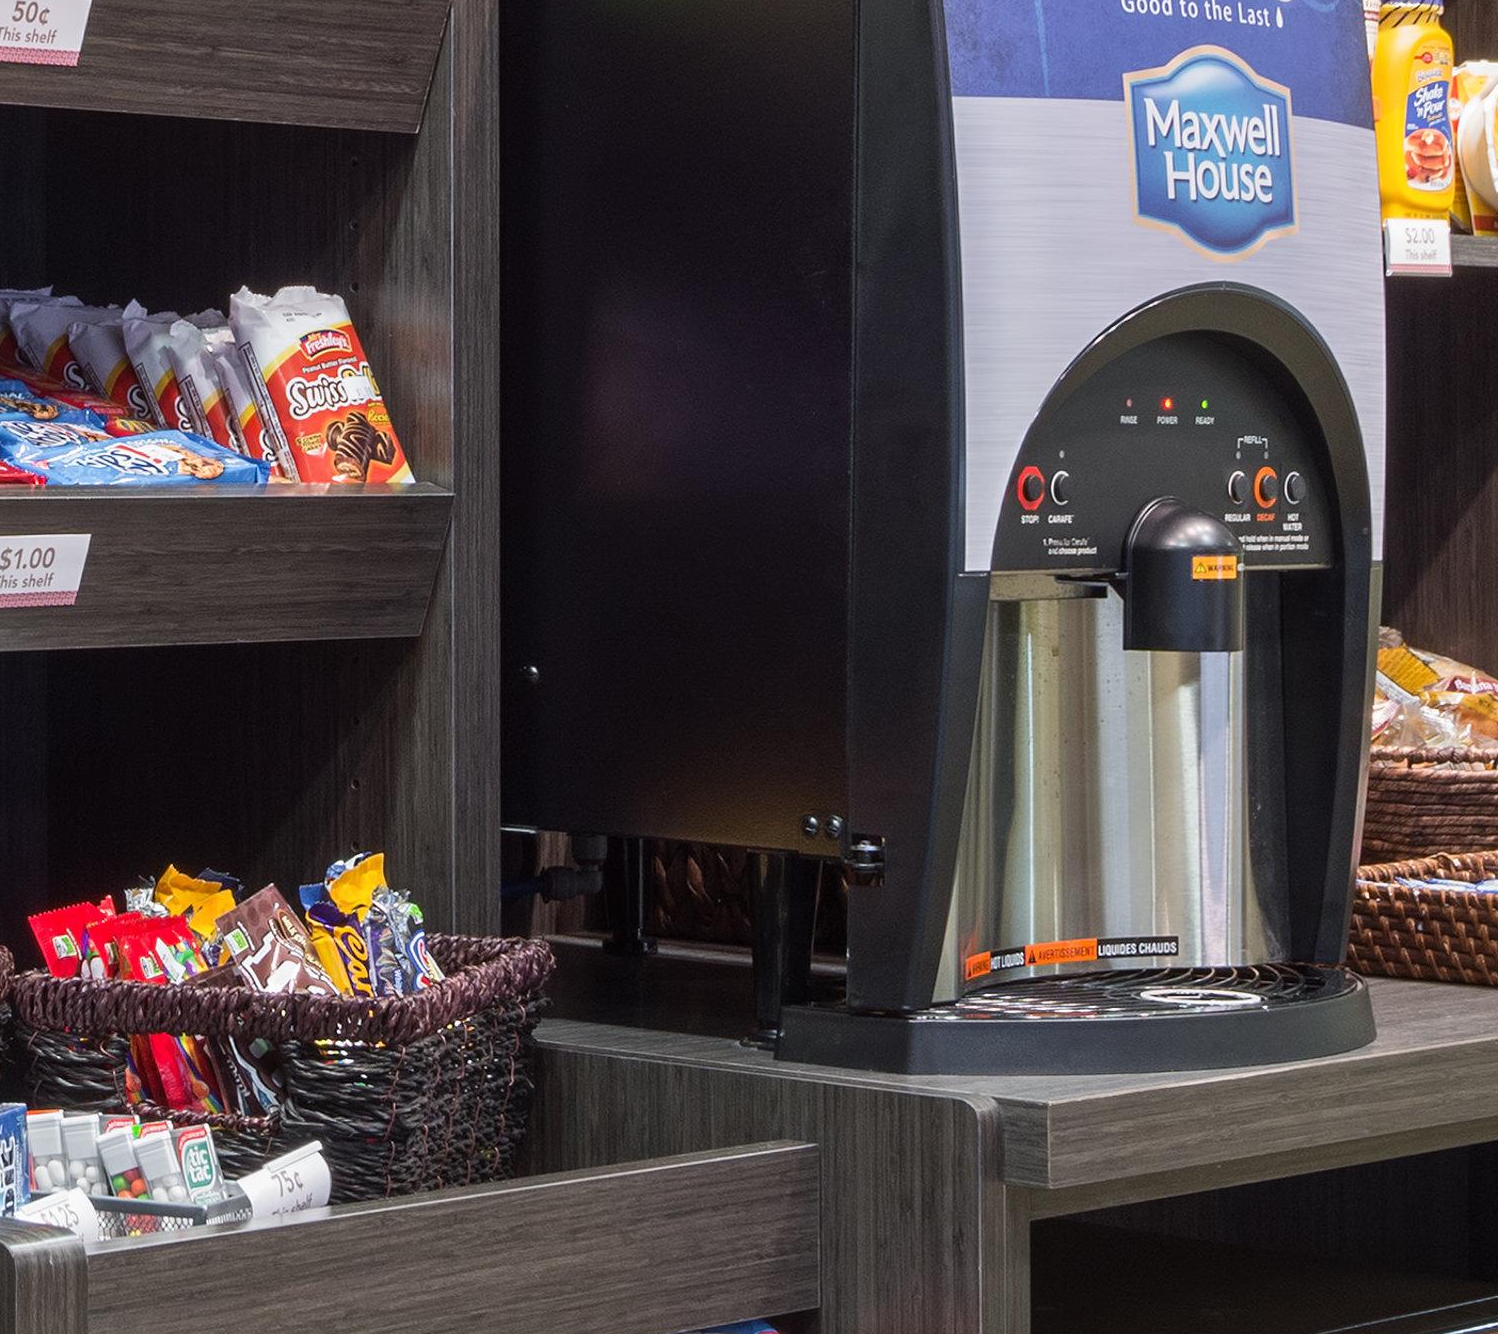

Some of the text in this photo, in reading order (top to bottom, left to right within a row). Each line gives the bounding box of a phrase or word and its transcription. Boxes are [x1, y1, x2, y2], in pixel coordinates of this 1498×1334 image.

[11, 0, 50, 25] 50¢
[1204, 2, 1233, 21] the
[1237, 7, 1271, 28] Last
[25, 28, 57, 46] shelf
[1143, 97, 1281, 158] Maxwell
[1163, 151, 1273, 204] House
[1404, 227, 1436, 245] $2.00
[21, 573, 54, 589] shelf
[188, 1148, 209, 1163] tic
[188, 1165, 211, 1183] tac
